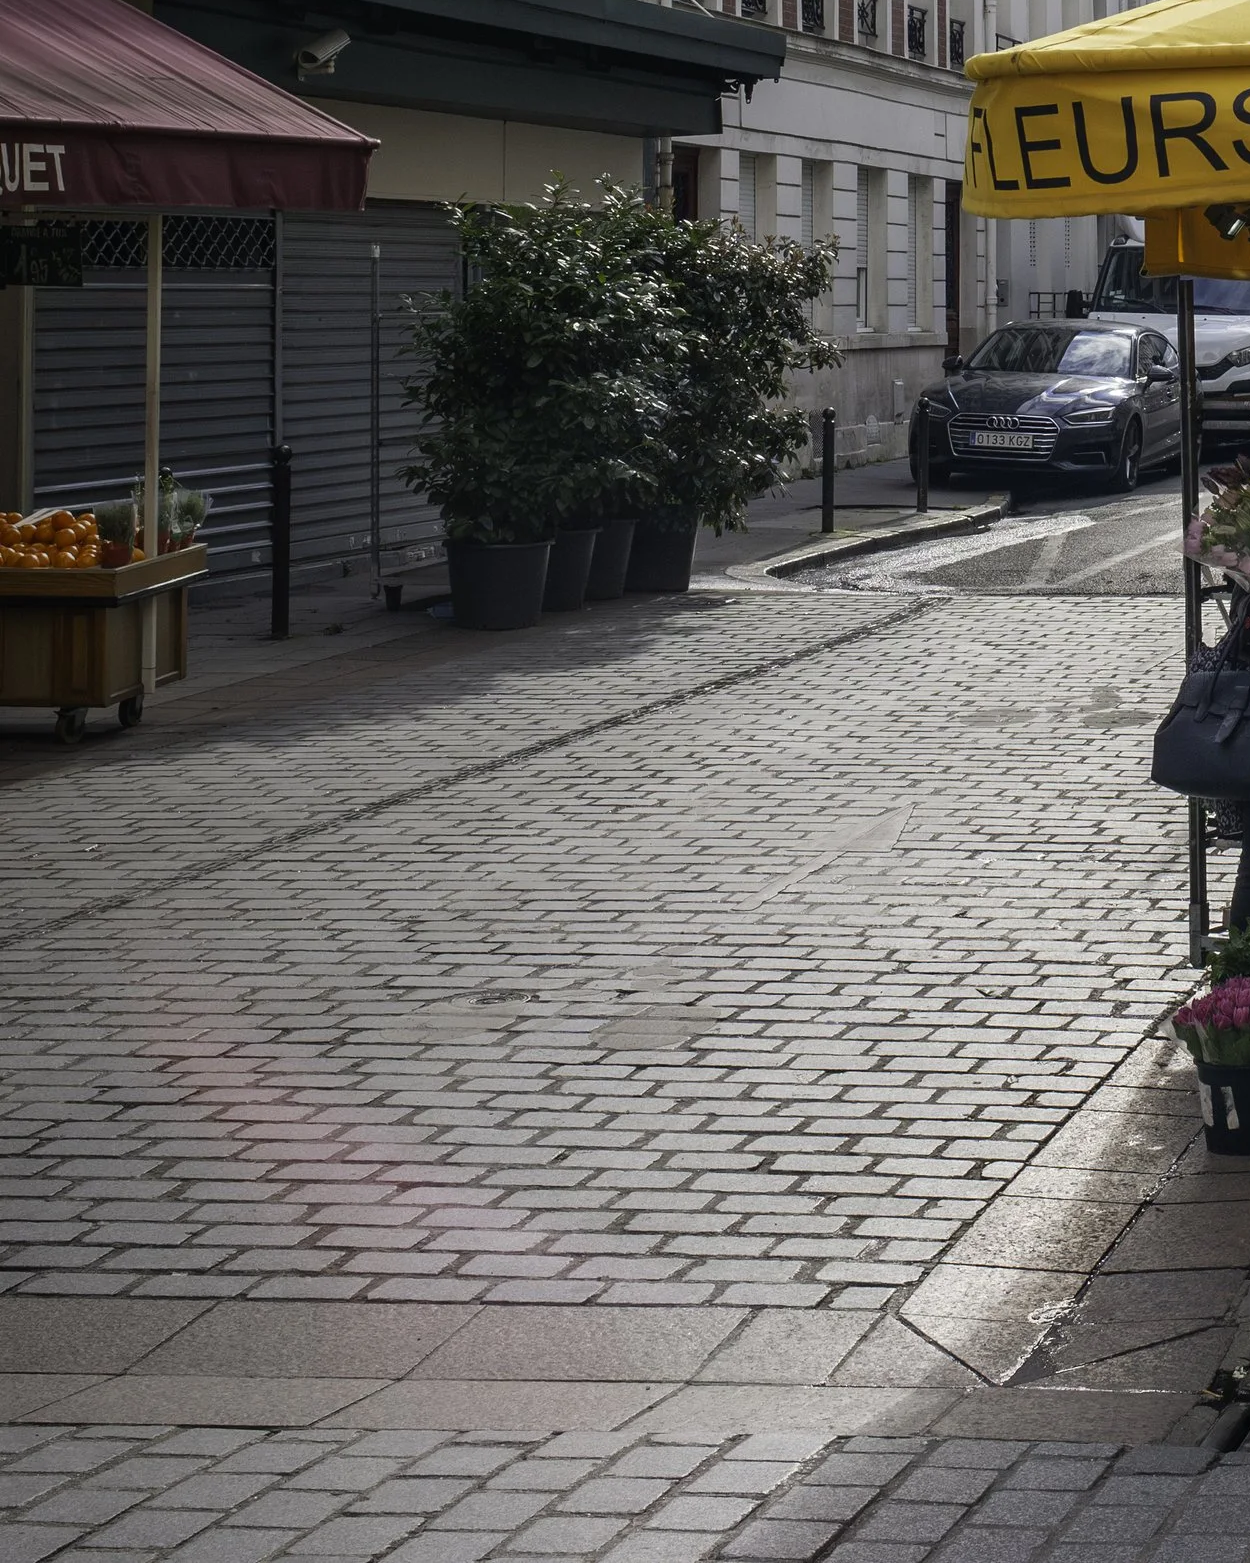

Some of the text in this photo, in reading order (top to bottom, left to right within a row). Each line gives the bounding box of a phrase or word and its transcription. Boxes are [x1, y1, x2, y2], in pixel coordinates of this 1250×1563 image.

[0, 142, 66, 195] UET
[977, 433, 1031, 447] 0133 KGZ
